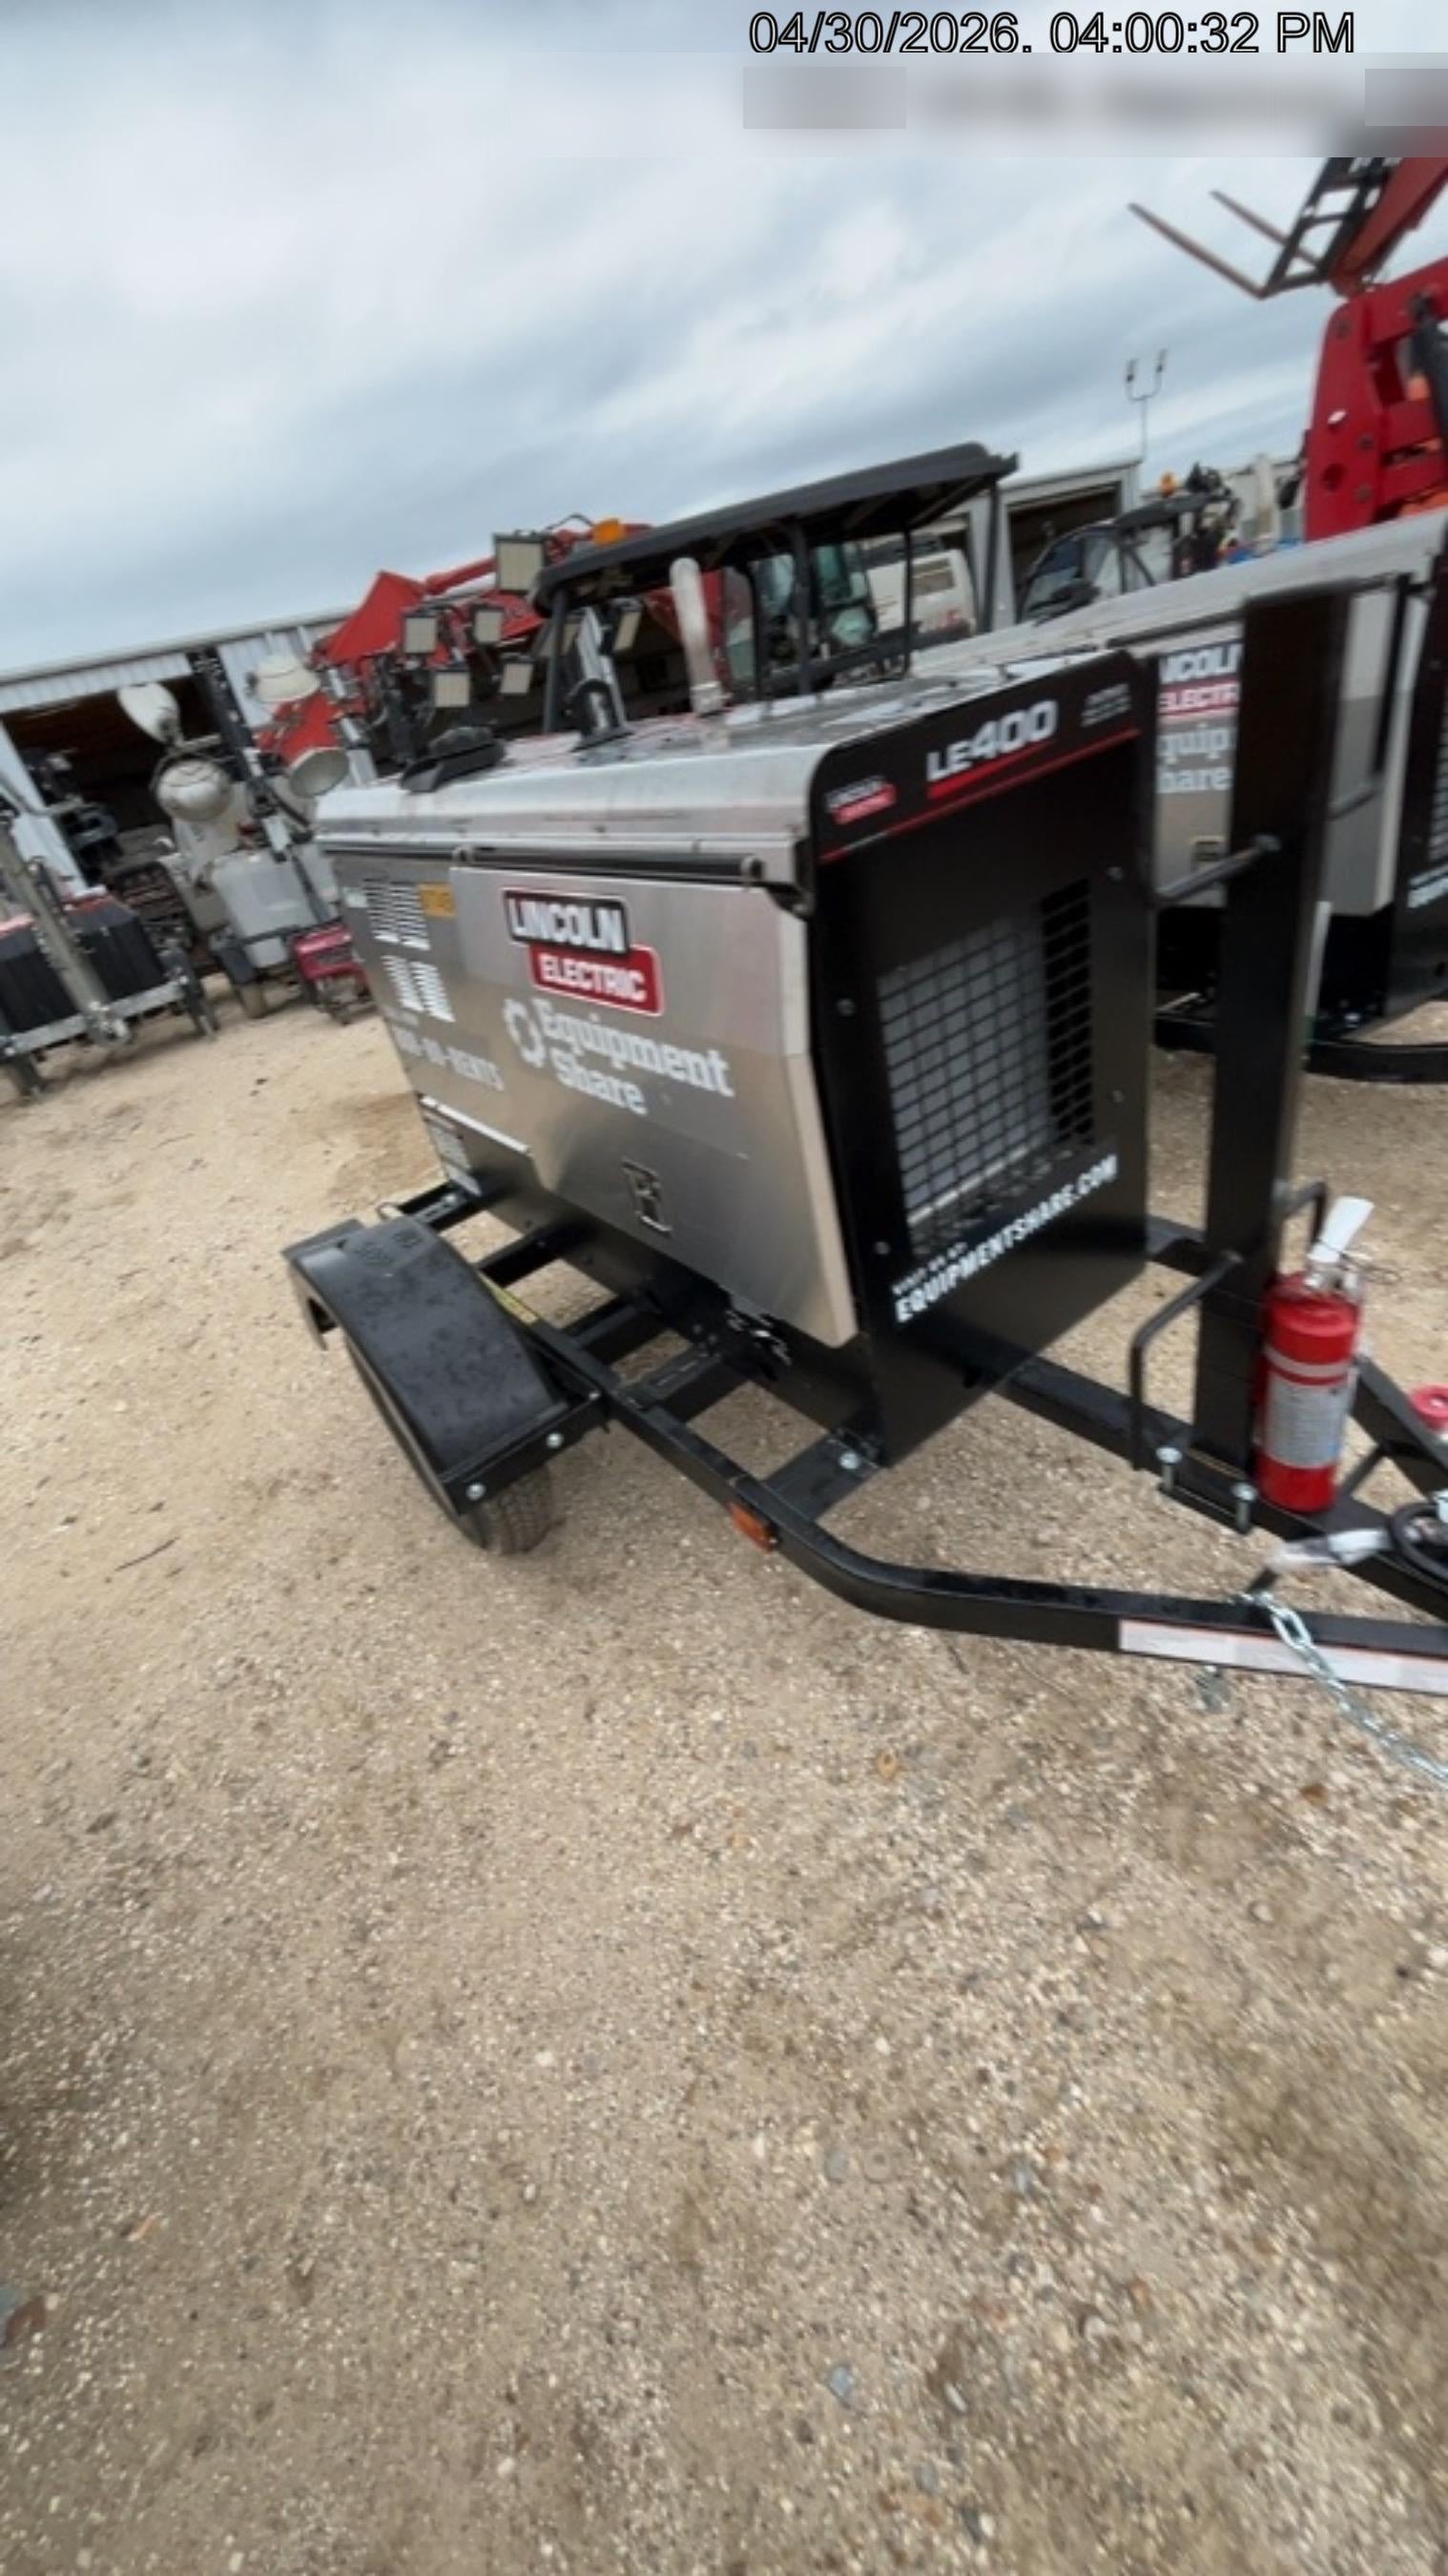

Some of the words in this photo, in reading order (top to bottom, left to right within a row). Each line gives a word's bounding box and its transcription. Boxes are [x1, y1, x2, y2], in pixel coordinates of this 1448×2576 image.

[927, 699, 1058, 781] LE400
[508, 899, 625, 952] LINCOLN
[542, 955, 647, 1003] ELECTRIC
[531, 997, 734, 1097] Equipment
[550, 1046, 648, 1115] Share
